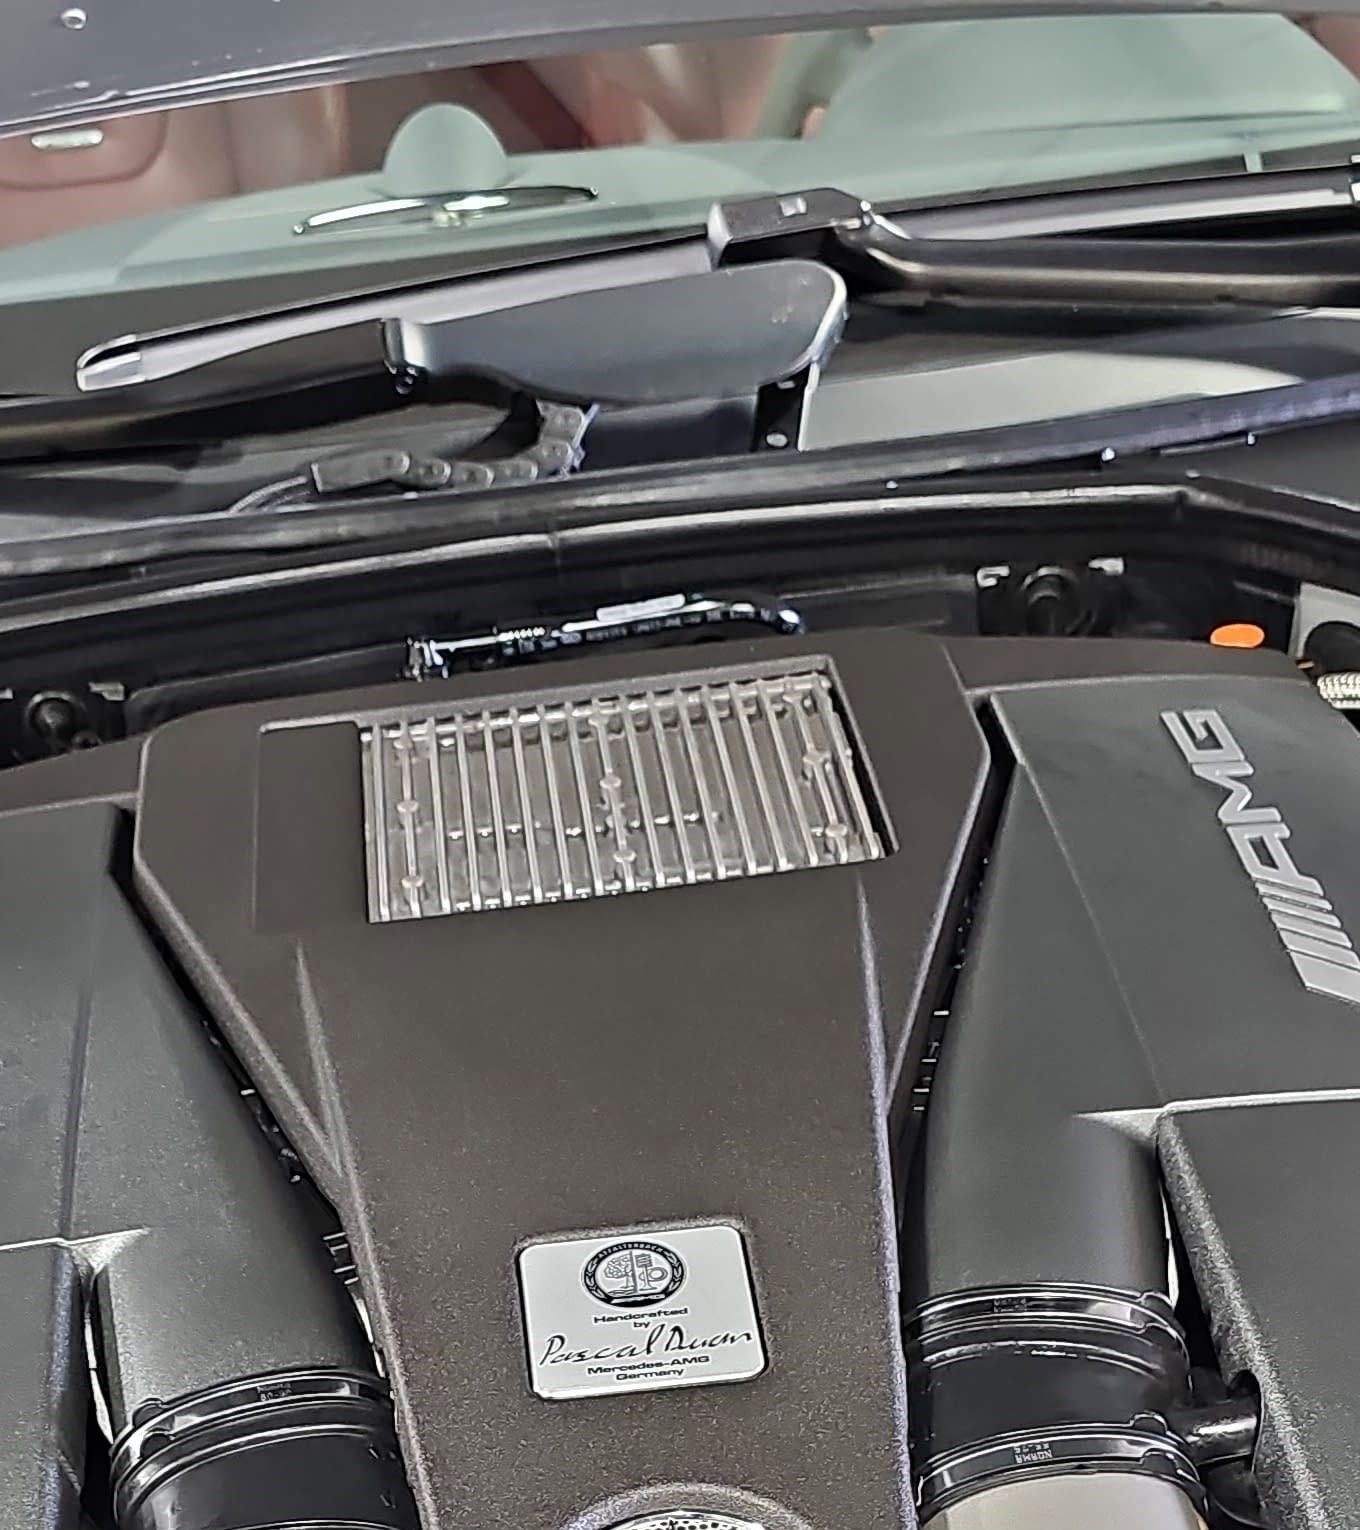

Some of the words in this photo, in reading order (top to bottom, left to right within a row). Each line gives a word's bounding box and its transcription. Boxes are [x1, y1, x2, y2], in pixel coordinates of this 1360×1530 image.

[1160, 708, 1340, 925] AMG
[594, 1307, 688, 1323] Handcrafted
[633, 1320, 650, 1330] by
[587, 1355, 710, 1375] Mercedes-AMG
[616, 1368, 684, 1381] Germany
